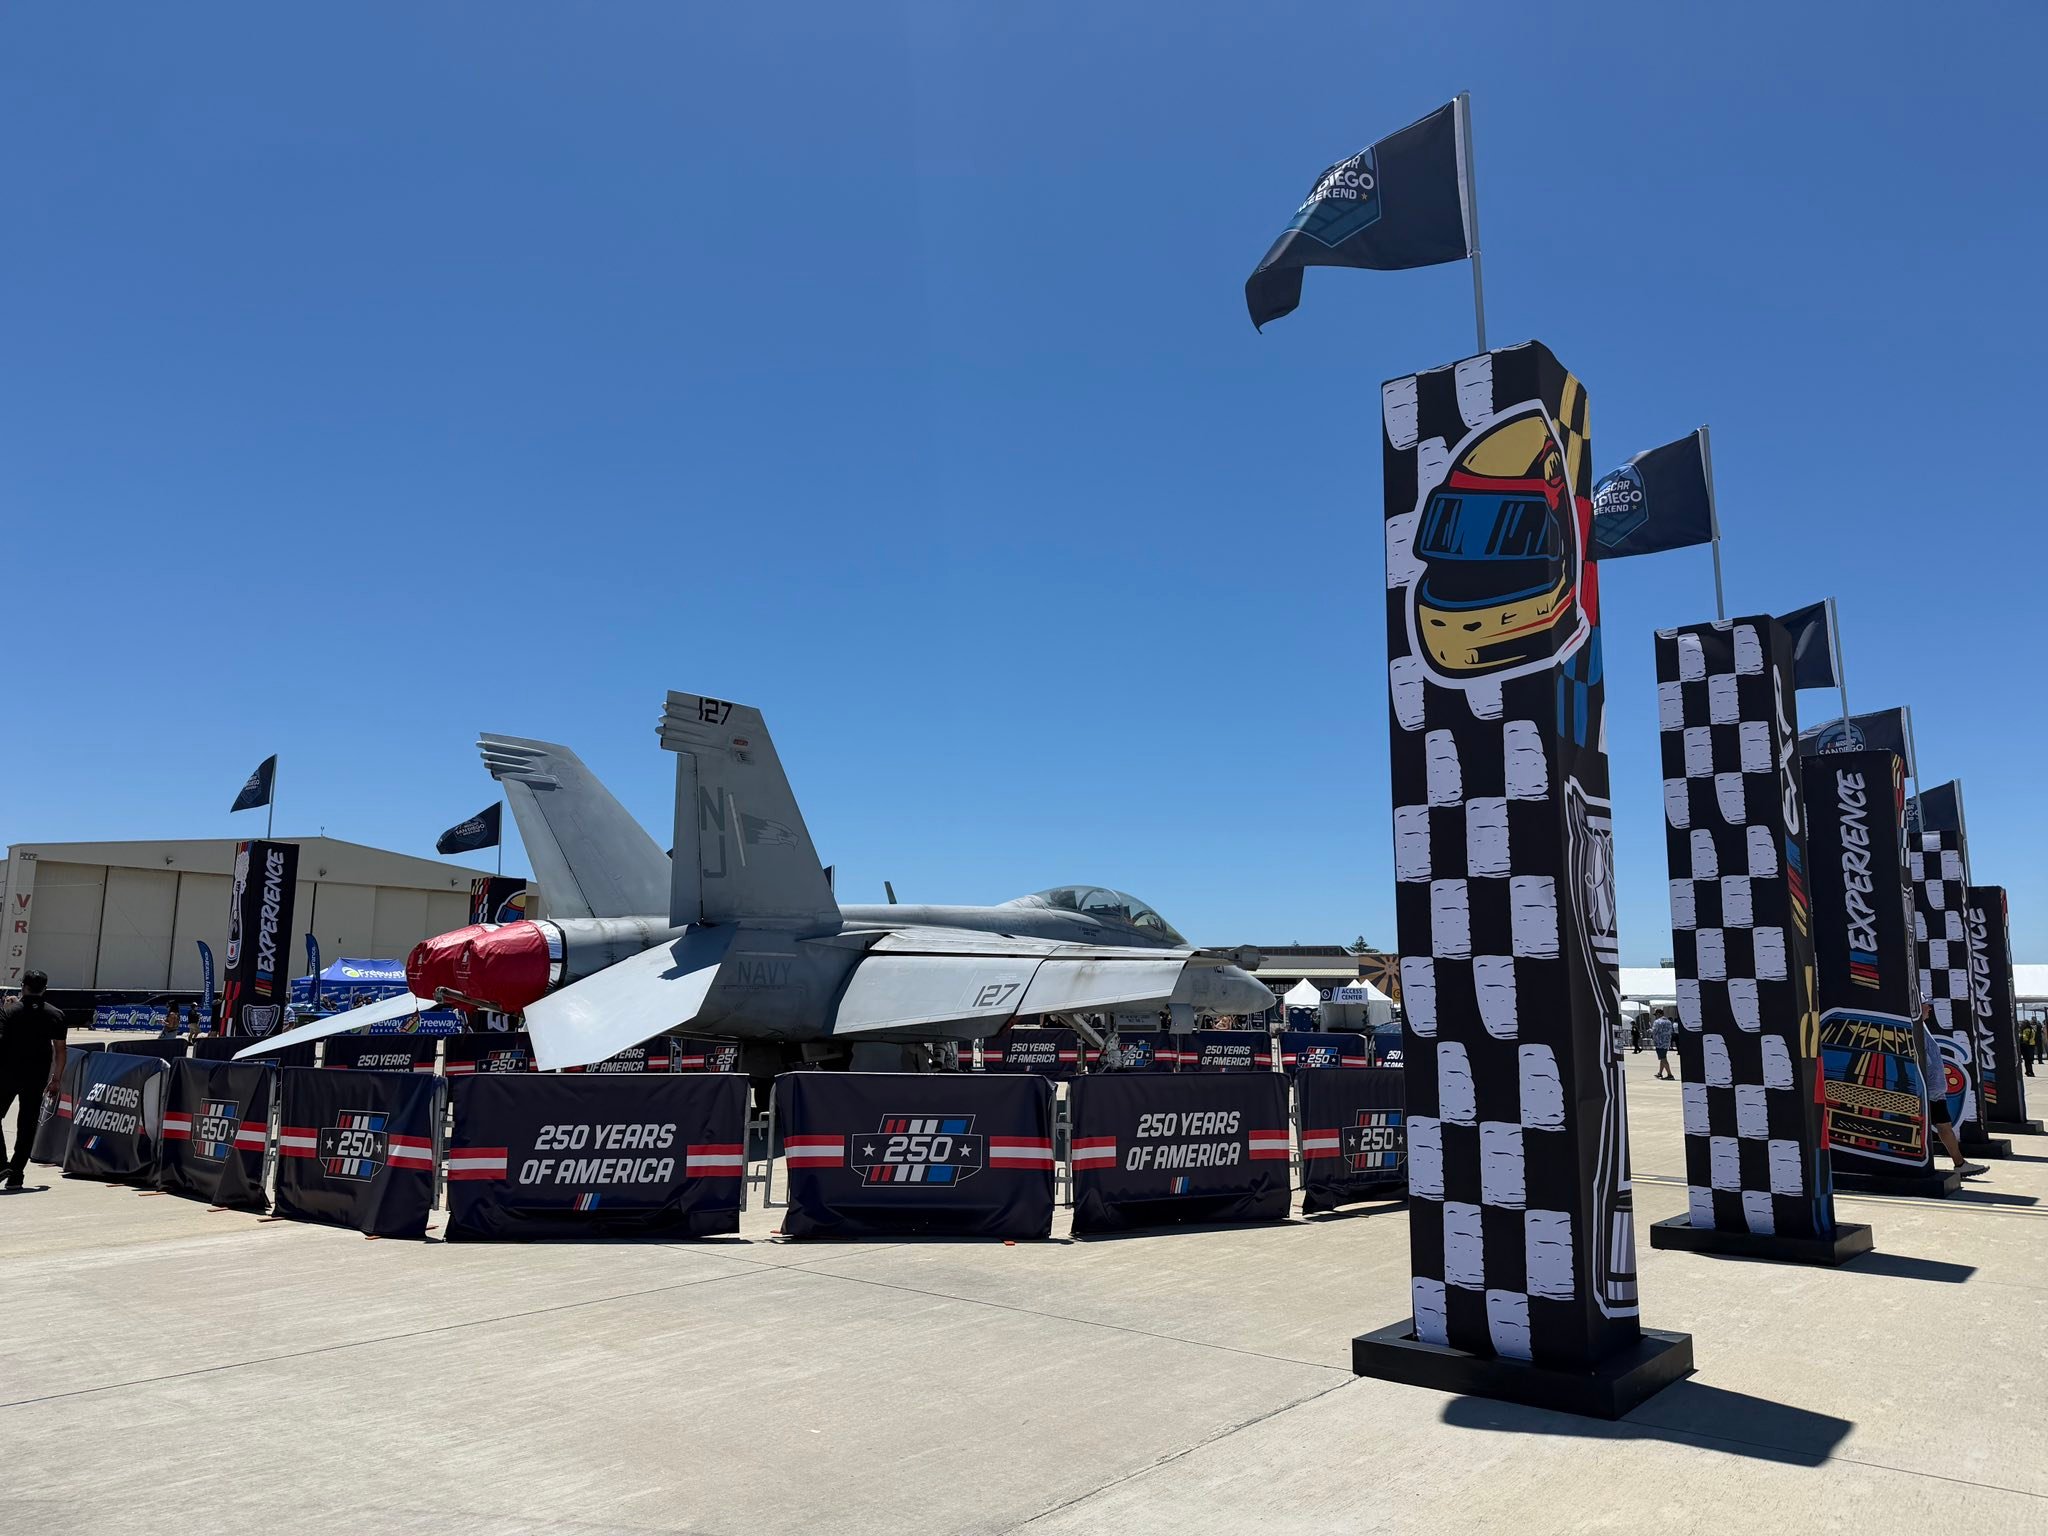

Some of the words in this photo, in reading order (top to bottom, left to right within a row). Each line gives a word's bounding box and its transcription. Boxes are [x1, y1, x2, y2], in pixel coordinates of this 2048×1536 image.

[1599, 490, 1643, 506] DIEGO
[1594, 504, 1629, 516] EEKEND
[698, 697, 733, 725] 127
[1836, 769, 1878, 952] EXPERIENCE
[257, 848, 285, 973] EXPERIENCE
[357, 969, 405, 979] Freeway
[738, 961, 792, 985] NAVY
[972, 983, 1021, 1007] 127
[372, 1019, 403, 1028] eeway
[419, 1018, 456, 1029] Freeway
[1011, 1043, 1028, 1052] 250
[1029, 1043, 1056, 1052] YEARS
[1019, 1054, 1056, 1063] AMERICA
[1205, 1046, 1222, 1055] 250
[1222, 1046, 1250, 1055] YEARS
[1307, 1054, 1330, 1064] 250
[358, 1055, 379, 1067] 250
[380, 1054, 411, 1066] YEARS
[490, 1059, 517, 1071] 250
[600, 1061, 645, 1072] AMERICA
[1201, 1057, 1213, 1066] OF
[1212, 1057, 1251, 1066] AMERICA
[104, 1085, 140, 1109] YEARS
[81, 1108, 137, 1135] AMERICA
[201, 1117, 229, 1142] 250
[1136, 1113, 1178, 1138] 250
[1179, 1110, 1241, 1136] YEARS
[337, 1131, 375, 1158] 250
[534, 1125, 591, 1150] 250
[594, 1123, 677, 1150] YEARS
[1360, 1128, 1394, 1151] 250
[883, 1136, 953, 1162] 250
[1125, 1145, 1157, 1171] OF
[1154, 1142, 1241, 1169] AMERICA
[519, 1160, 552, 1185] OF
[553, 1157, 676, 1184] AMERICA
